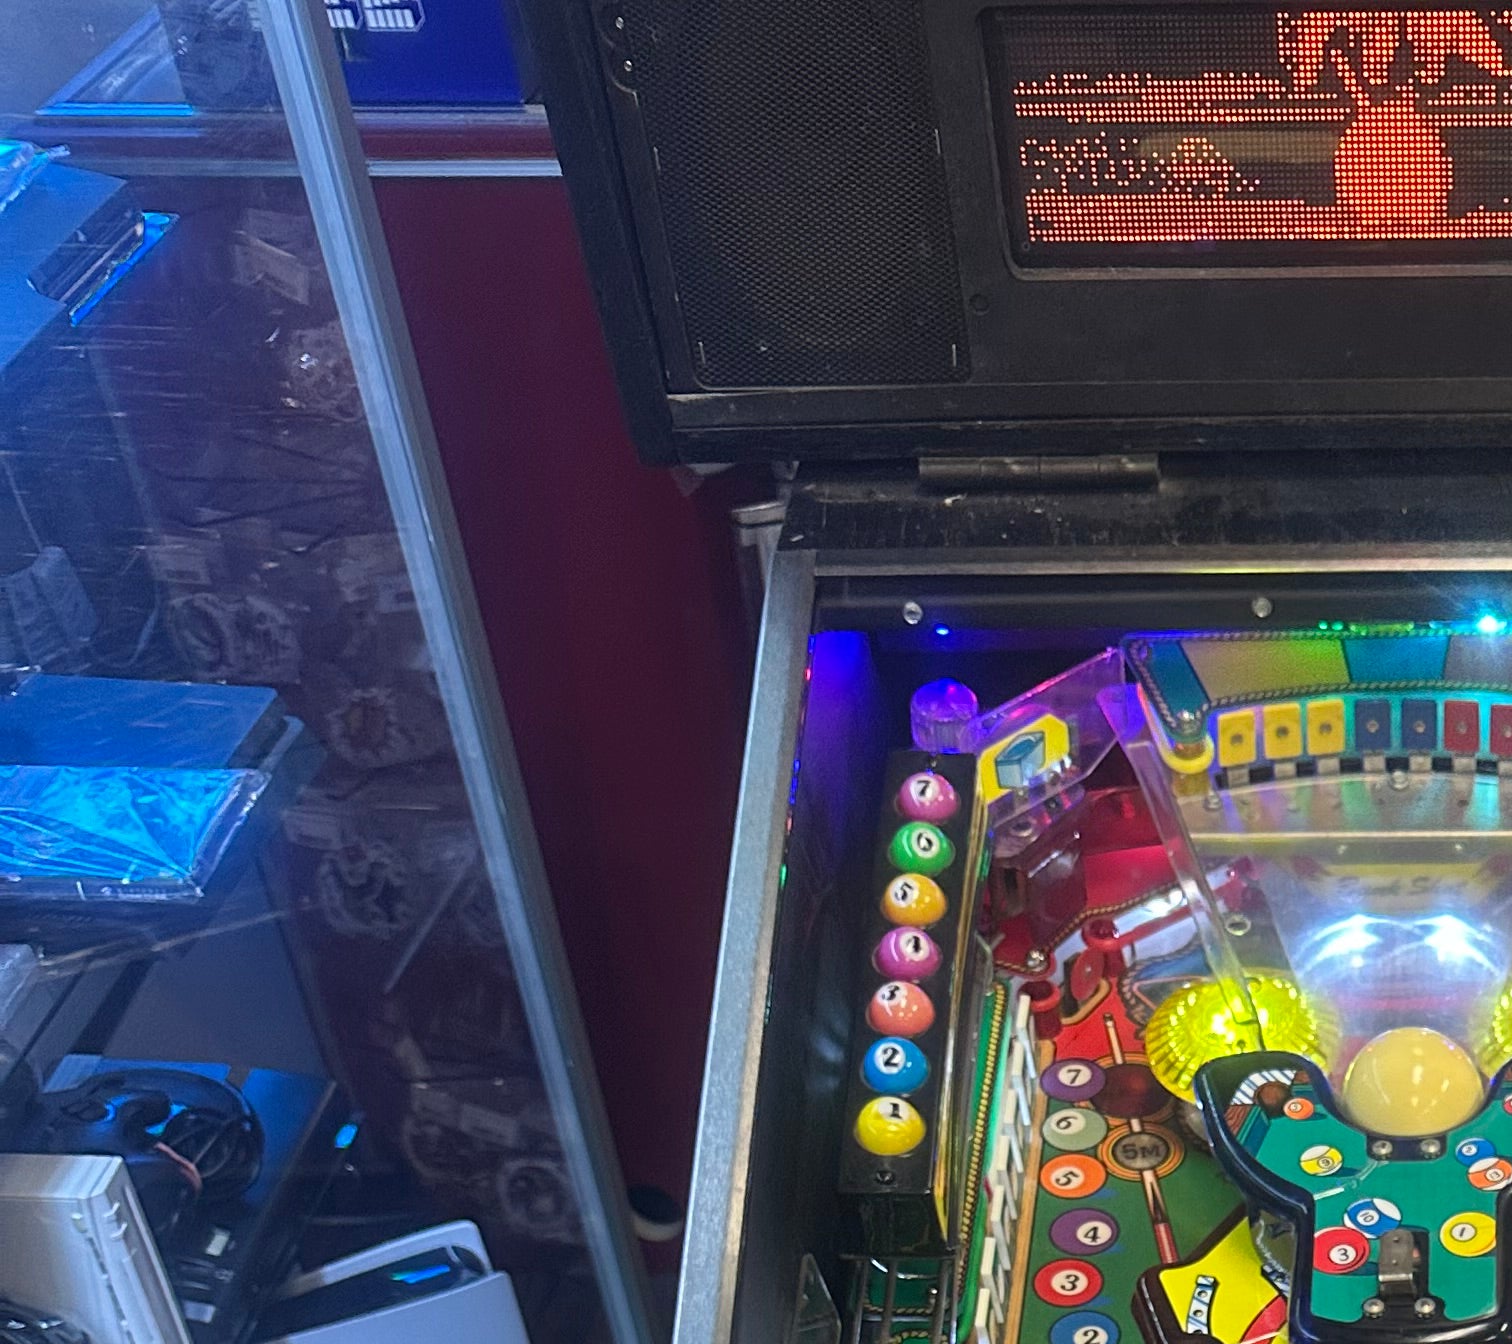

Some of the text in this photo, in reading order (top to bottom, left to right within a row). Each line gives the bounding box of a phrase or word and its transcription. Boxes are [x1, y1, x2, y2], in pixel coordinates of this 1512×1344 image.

[1067, 1070, 1081, 1083] 7
[1057, 1116, 1076, 1129] 6
[1057, 1171, 1080, 1186] 5
[1083, 1225, 1101, 1242] 4
[1061, 1274, 1080, 1291] 3
